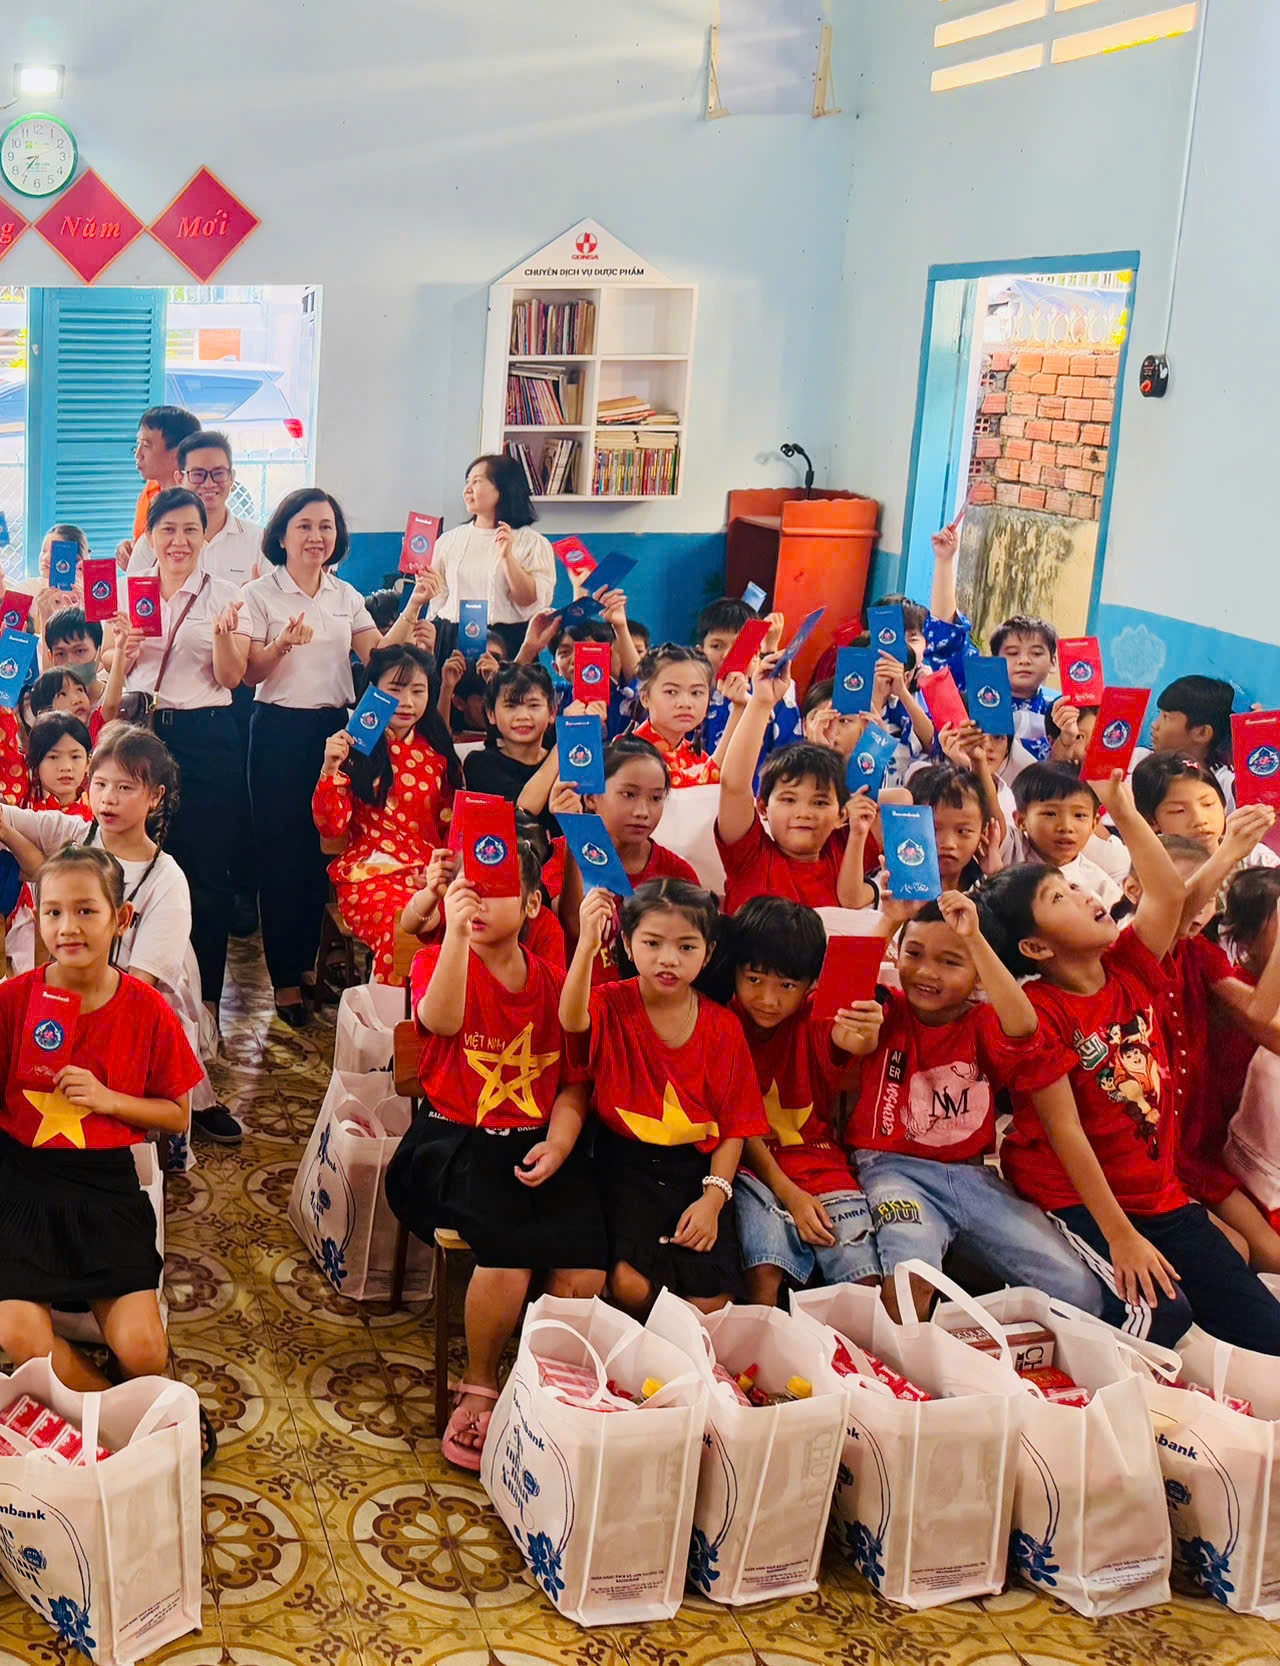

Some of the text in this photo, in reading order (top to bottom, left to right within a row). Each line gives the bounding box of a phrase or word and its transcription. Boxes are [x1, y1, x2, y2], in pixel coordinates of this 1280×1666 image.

[21, 128, 29, 138] 11
[33, 124, 43, 135] 12
[50, 128, 54, 139] 1
[12, 138, 21, 149] 10
[56, 139, 64, 149] 2
[7, 152, 15, 161] 9
[59, 152, 66, 161] 3
[12, 166, 19, 175] 8
[56, 167, 63, 176] 4
[33, 179, 41, 189] 6
[47, 175, 54, 185] 5
[60, 216, 121, 239] Năm
[177, 209, 230, 239] Mới
[524, 266, 644, 277] CHUYÊN DỊCH VỤ DƯỢC PHẨM
[464, 1032, 485, 1050] VIỆT
